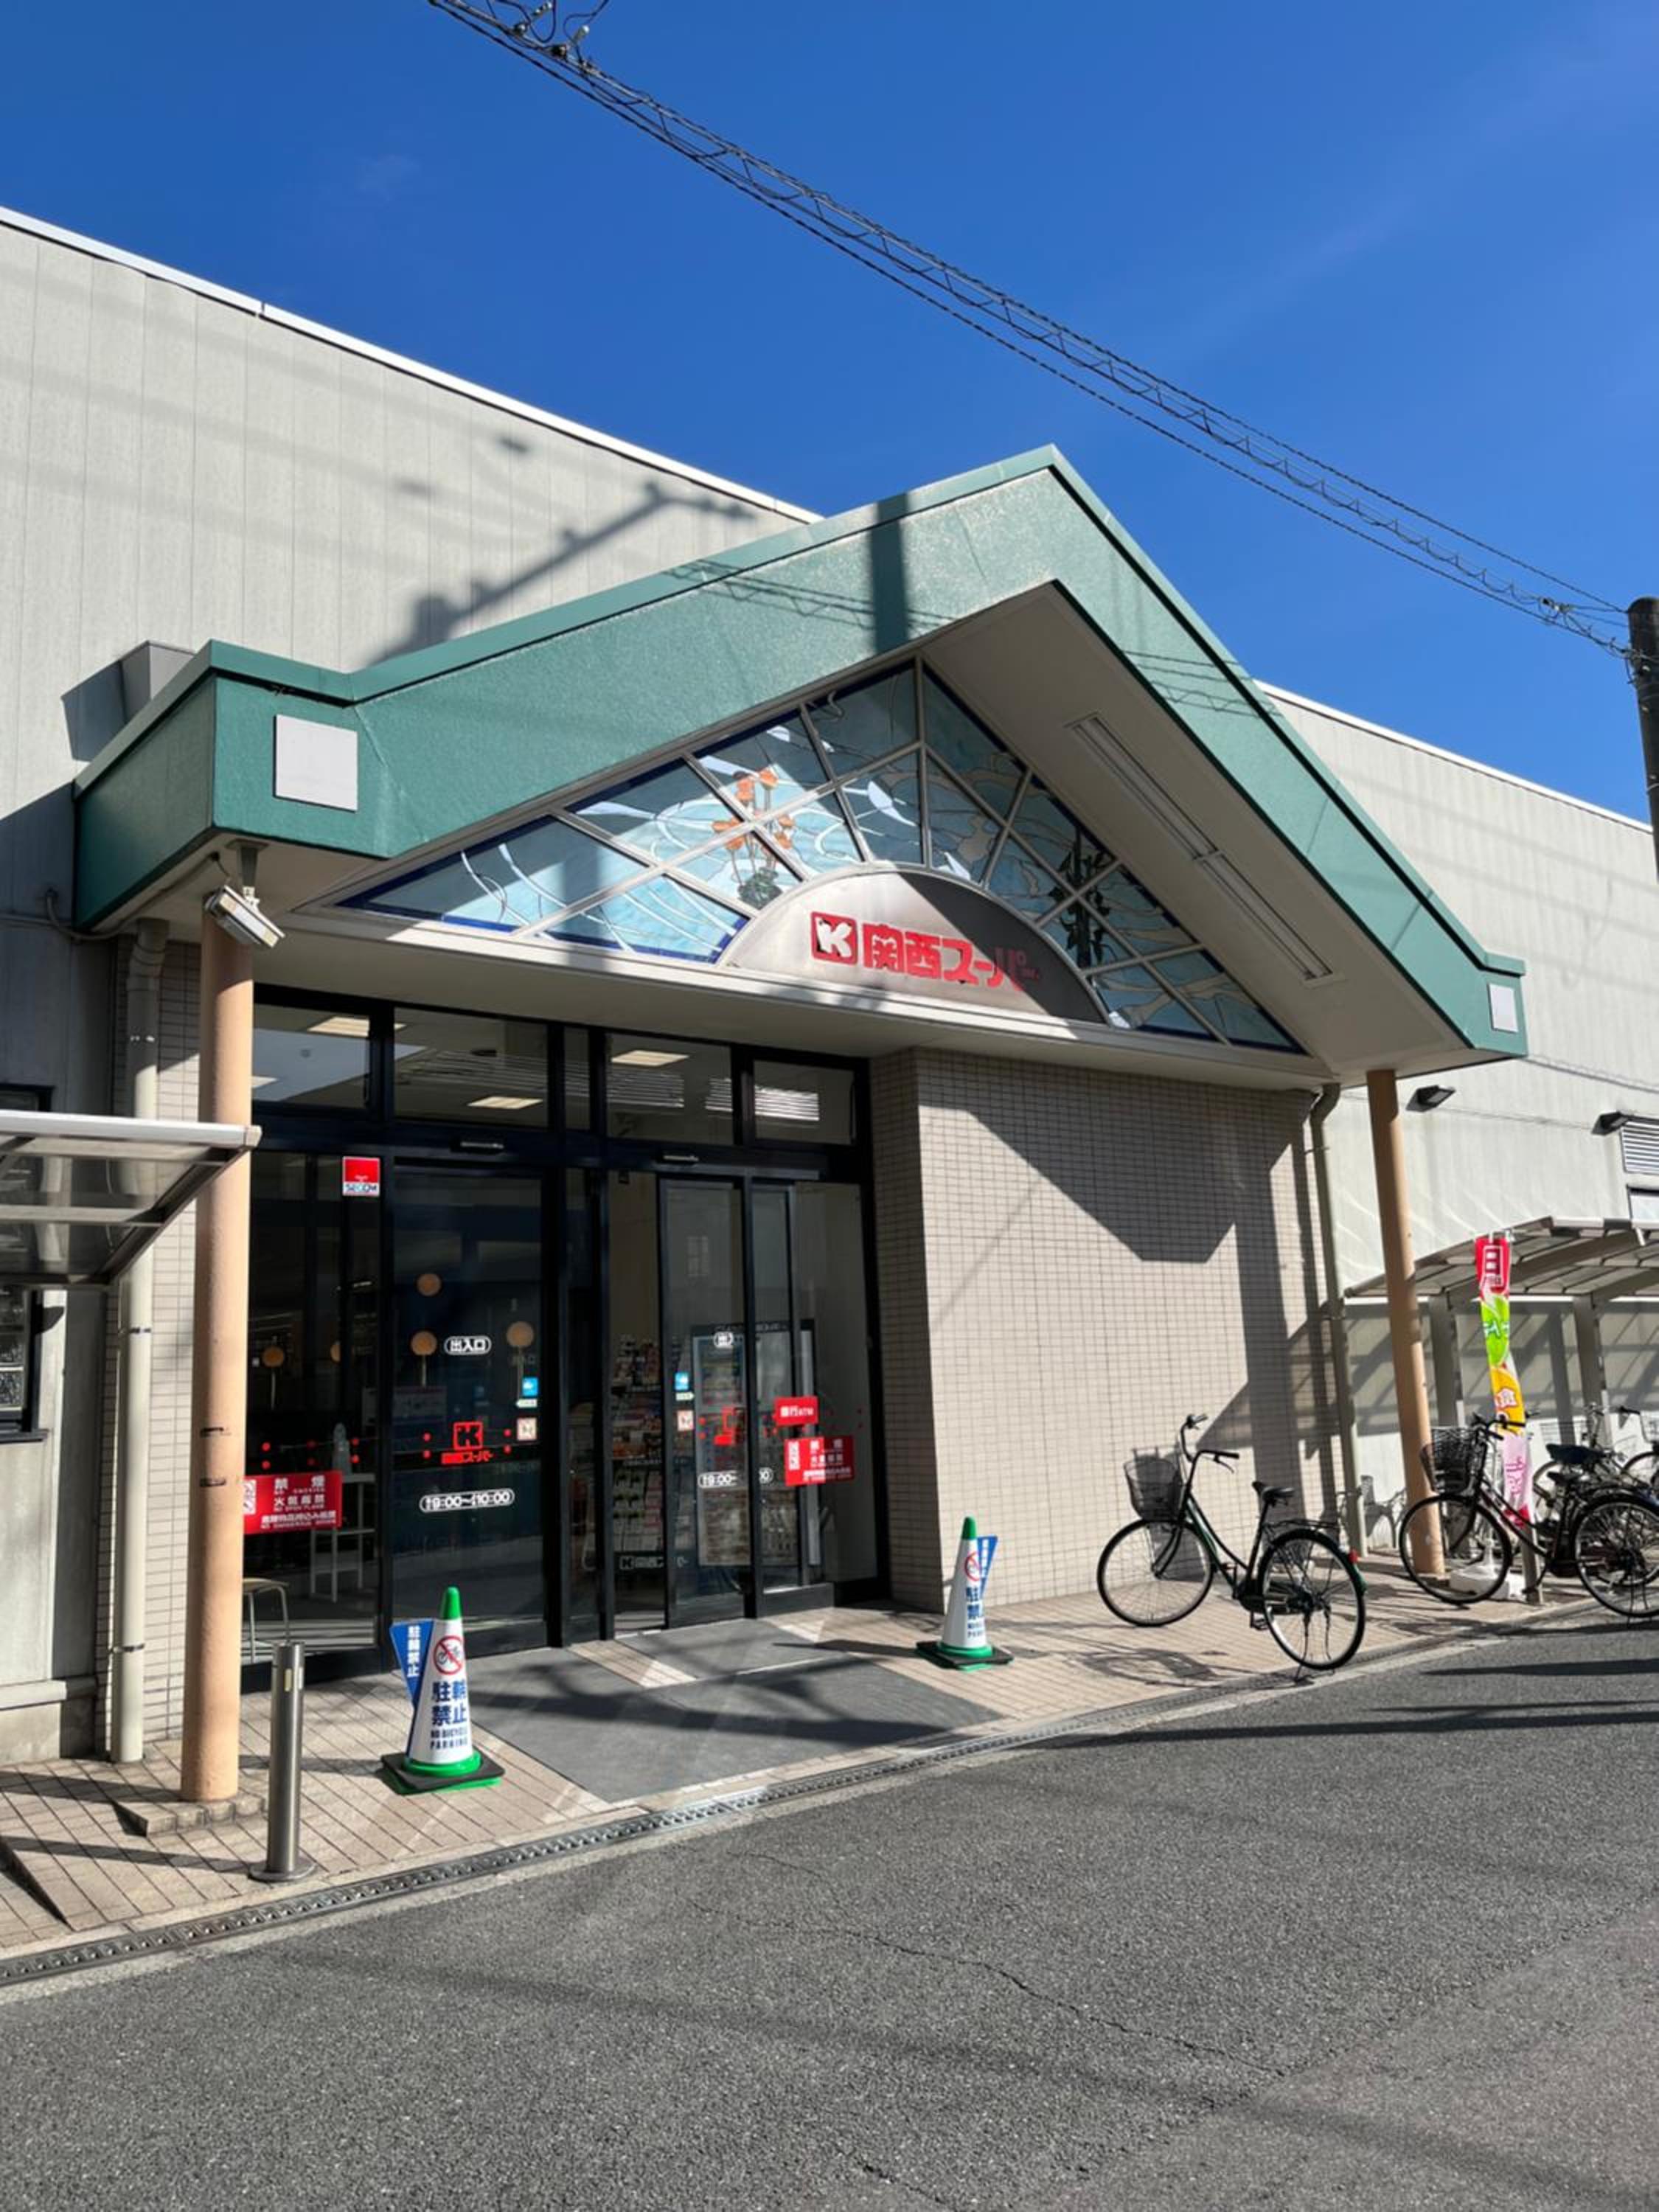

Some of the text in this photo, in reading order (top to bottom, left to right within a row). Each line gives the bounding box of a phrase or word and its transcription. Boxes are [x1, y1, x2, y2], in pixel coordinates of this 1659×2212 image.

[862, 922, 1040, 992] 関西スーパー
[450, 1338, 487, 1352] 出入口
[442, 1450, 493, 1465] スーパー
